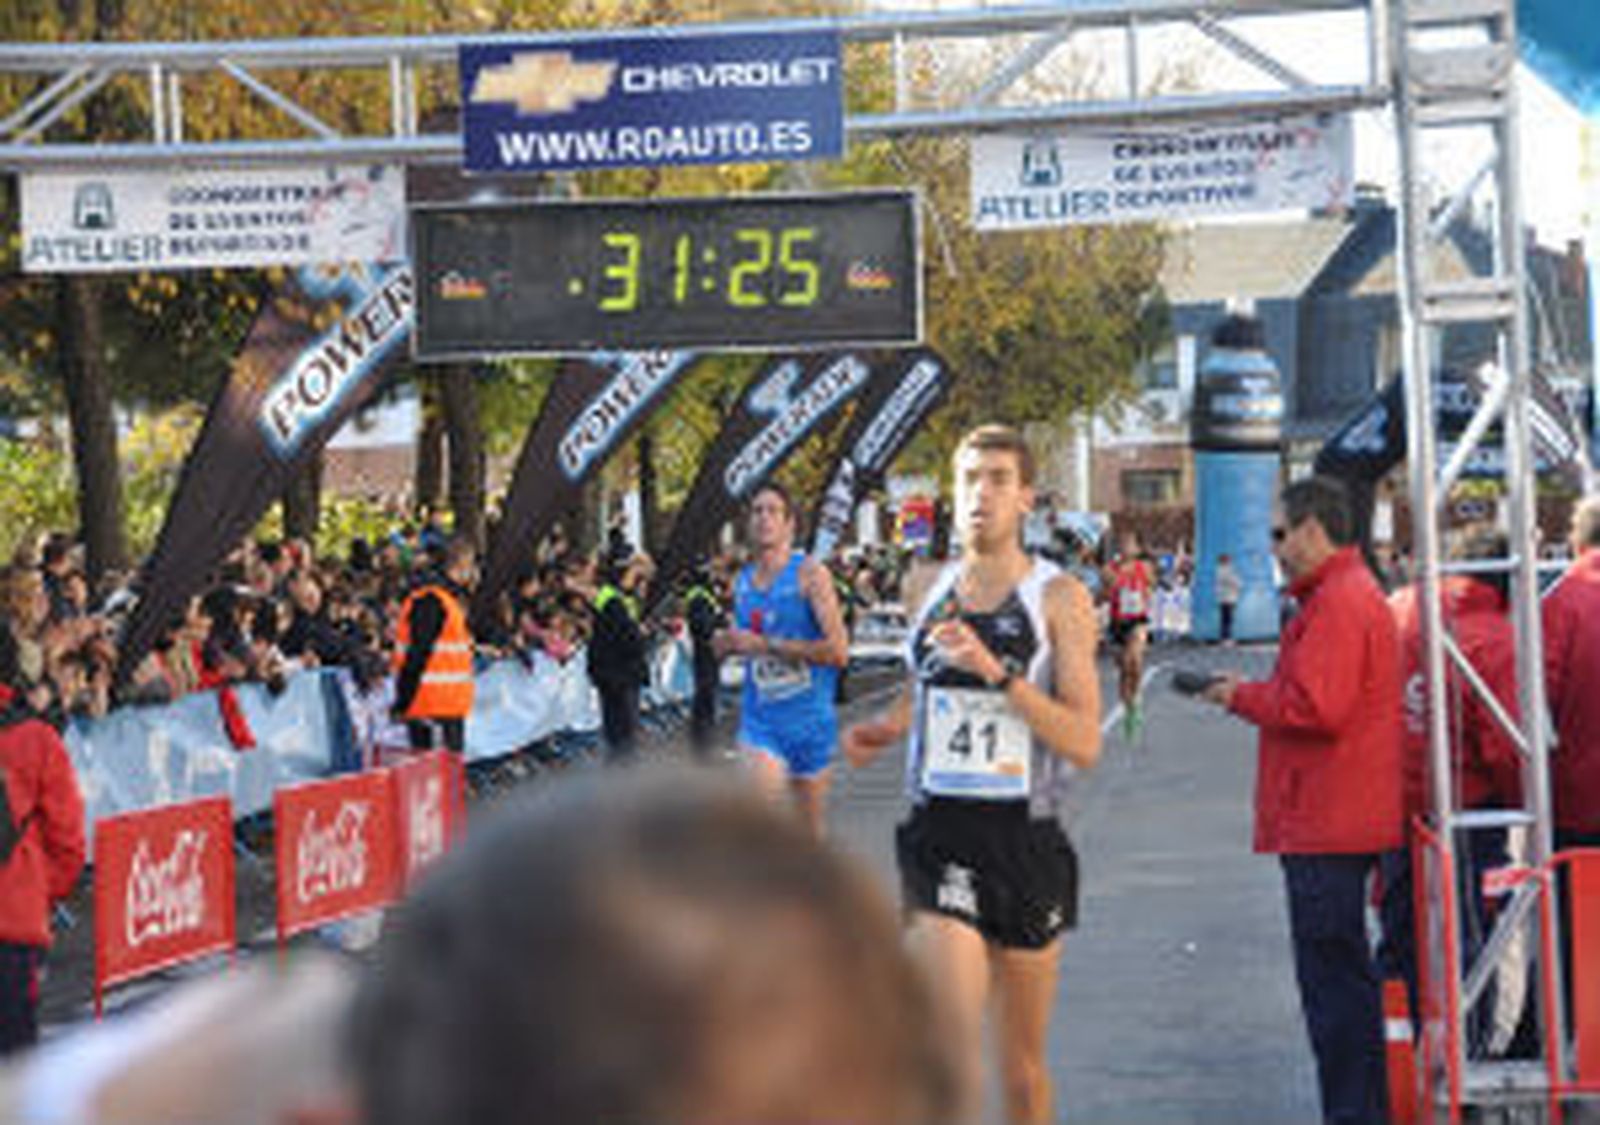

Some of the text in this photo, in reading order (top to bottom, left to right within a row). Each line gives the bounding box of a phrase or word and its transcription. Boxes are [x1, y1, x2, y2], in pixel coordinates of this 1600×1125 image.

[622, 57, 836, 93] CHEVROLET
[978, 187, 1111, 222] ATELIER
[27, 233, 163, 263] ATELIER
[948, 720, 998, 762] 41
